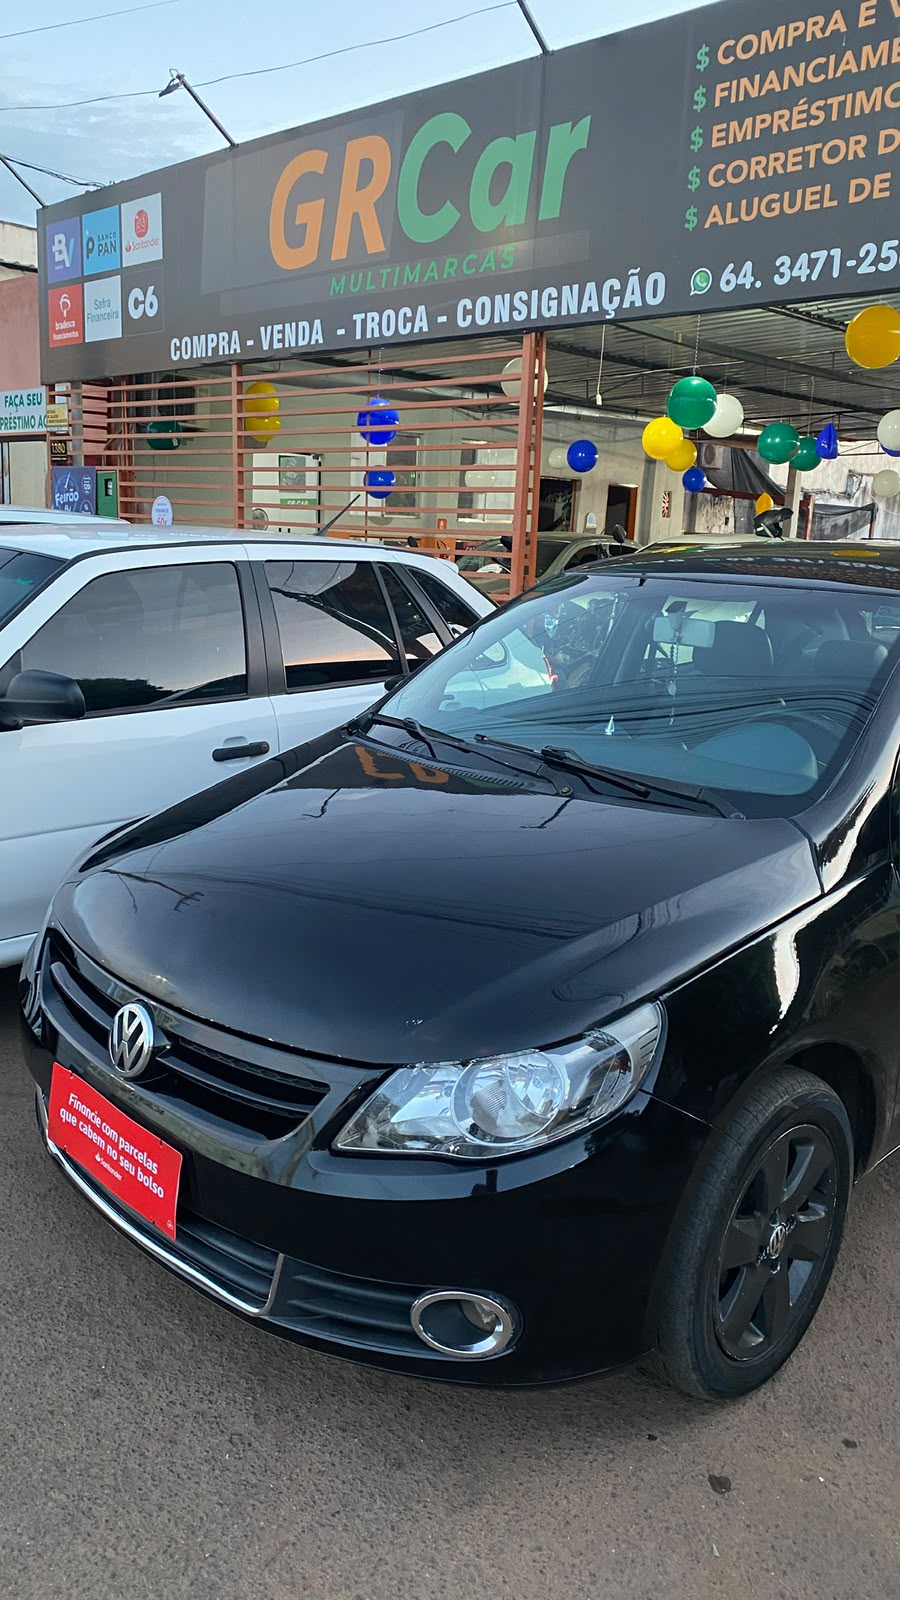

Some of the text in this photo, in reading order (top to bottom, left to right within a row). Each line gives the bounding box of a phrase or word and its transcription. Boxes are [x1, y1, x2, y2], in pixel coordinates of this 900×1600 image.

[717, 9, 847, 65] COMPRA
[858, 0, 878, 28] E
[708, 134, 867, 188] CORRETOR
[269, 112, 592, 270] GRCar
[704, 183, 838, 229] ALUGUEL
[848, 172, 892, 204] DE
[97, 231, 117, 242] BANCO
[98, 240, 117, 257] PAN
[132, 238, 160, 252] Santander
[330, 245, 517, 297] MULTIMARCAS
[719, 240, 900, 292] 64. 3471-25
[87, 308, 119, 325] Financeira
[94, 298, 111, 311] Safra
[128, 285, 159, 320] C6
[170, 330, 242, 361] COMPRA
[260, 319, 324, 351] VENDA
[353, 305, 429, 340] TROCA
[457, 267, 666, 329] CONSIGNAÇÃO
[55, 320, 76, 331] bradesco
[4, 393, 42, 412] FAÇA SEU
[55, 489, 79, 507] Feirão
[68, 1092, 158, 1175] Financie com parcelas
[60, 1108, 165, 1199] que cabem no seu bolso
[100, 1158, 123, 1182] Santander
